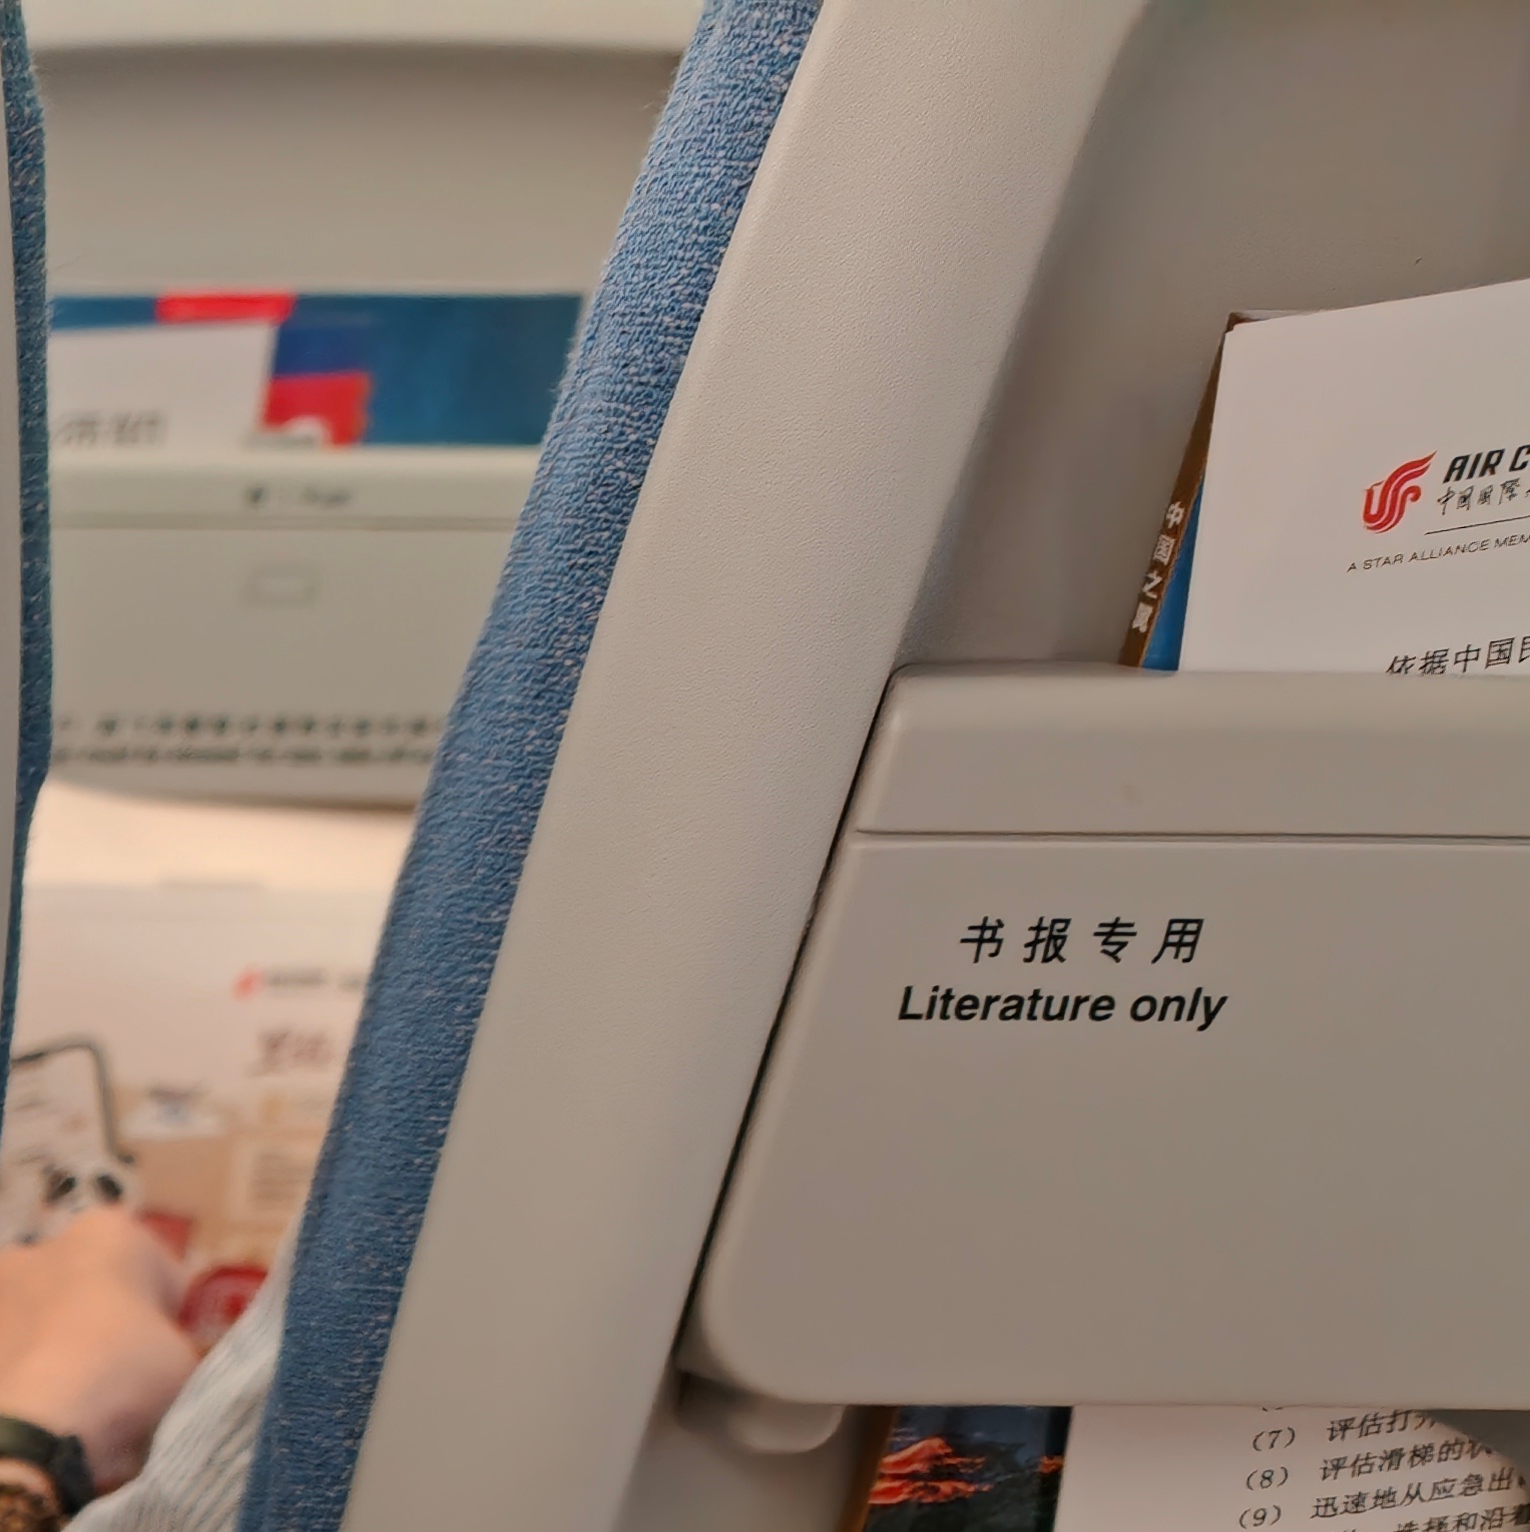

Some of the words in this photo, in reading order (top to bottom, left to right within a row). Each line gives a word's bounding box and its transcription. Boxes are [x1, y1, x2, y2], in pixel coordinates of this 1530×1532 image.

[1442, 448, 1506, 485] AIR
[1362, 553, 1404, 573] STAR
[1408, 538, 1490, 563] ALLIANCE
[958, 915, 1206, 964] 书报专用
[897, 984, 1116, 1022] Literature
[1129, 986, 1229, 1033] only
